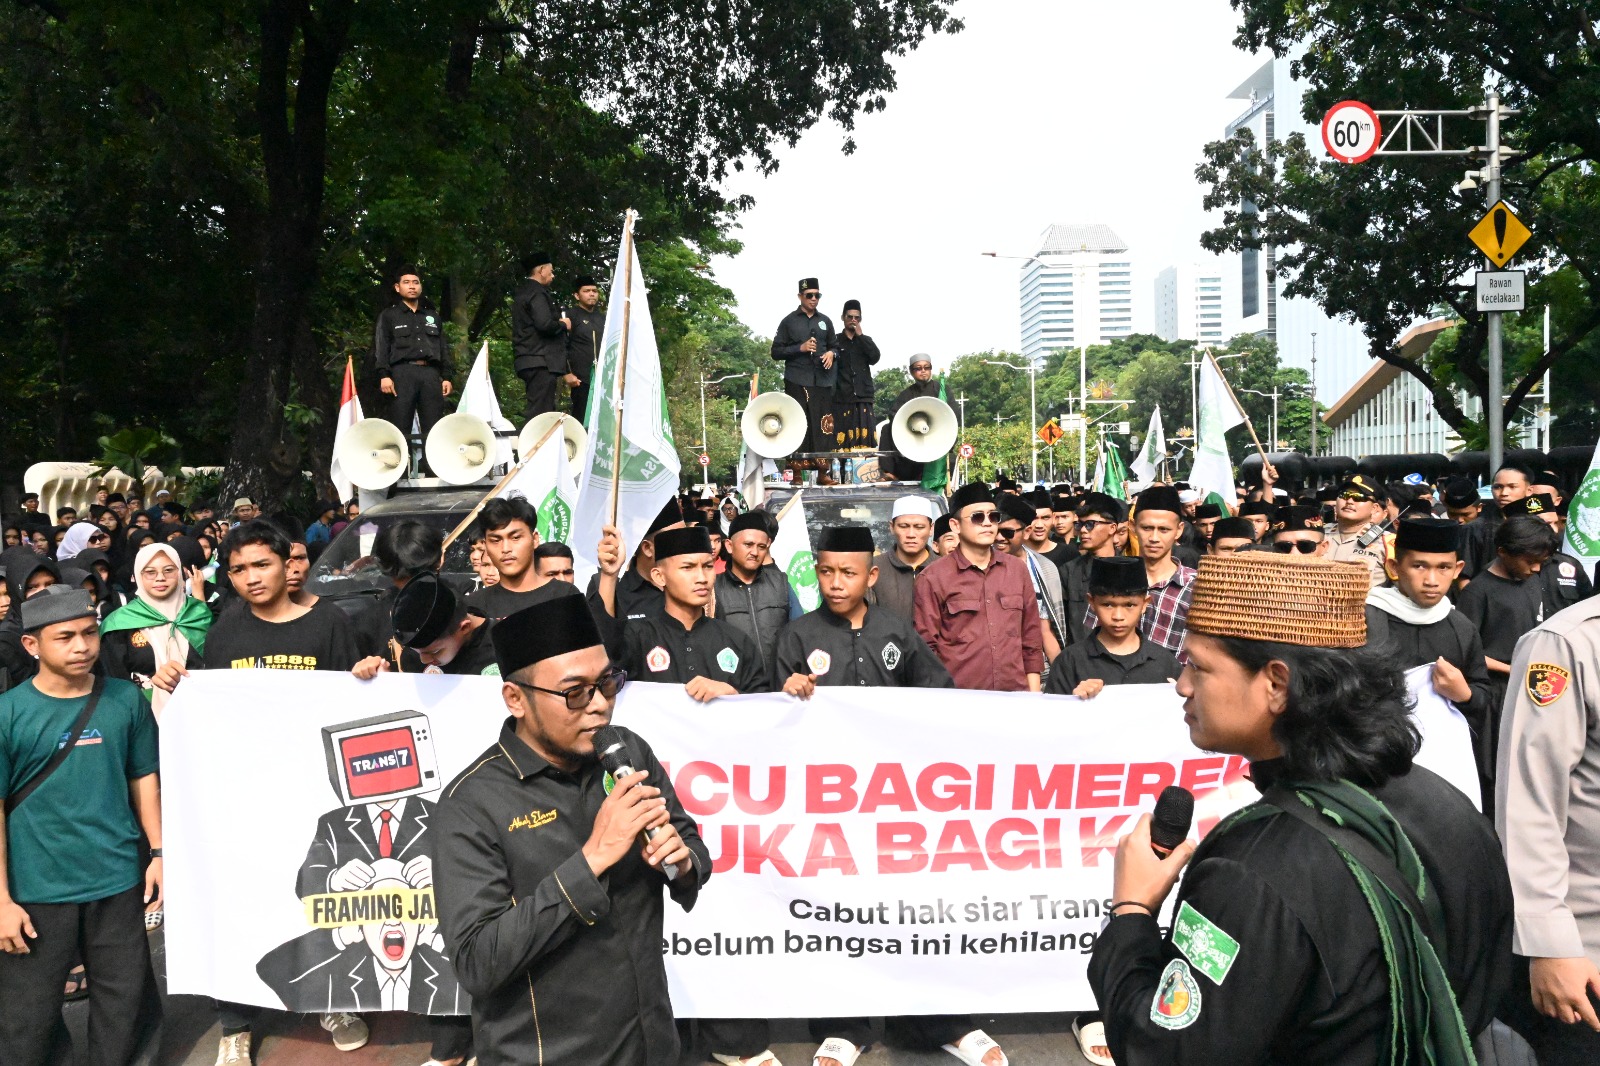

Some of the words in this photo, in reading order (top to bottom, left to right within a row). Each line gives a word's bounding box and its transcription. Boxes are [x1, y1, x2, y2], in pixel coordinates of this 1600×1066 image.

[1333, 120, 1360, 148] 60
[1359, 120, 1371, 132] km
[1489, 278, 1512, 289] Rawan
[1481, 292, 1520, 304] Kecelakaan
[1571, 532, 1590, 556] NUSA
[262, 654, 317, 666] 1986
[659, 761, 787, 816] CU
[805, 762, 996, 814] BAGI
[697, 822, 859, 878] UKA
[876, 817, 1063, 875] BAGI
[312, 893, 403, 924] FRAMING
[407, 893, 438, 920] JA
[789, 898, 890, 925] Cabut
[898, 898, 957, 925] hak
[964, 896, 1023, 924] siar
[784, 929, 902, 958] bangsa
[911, 933, 951, 956] ini
[960, 931, 1098, 955] kehilang
